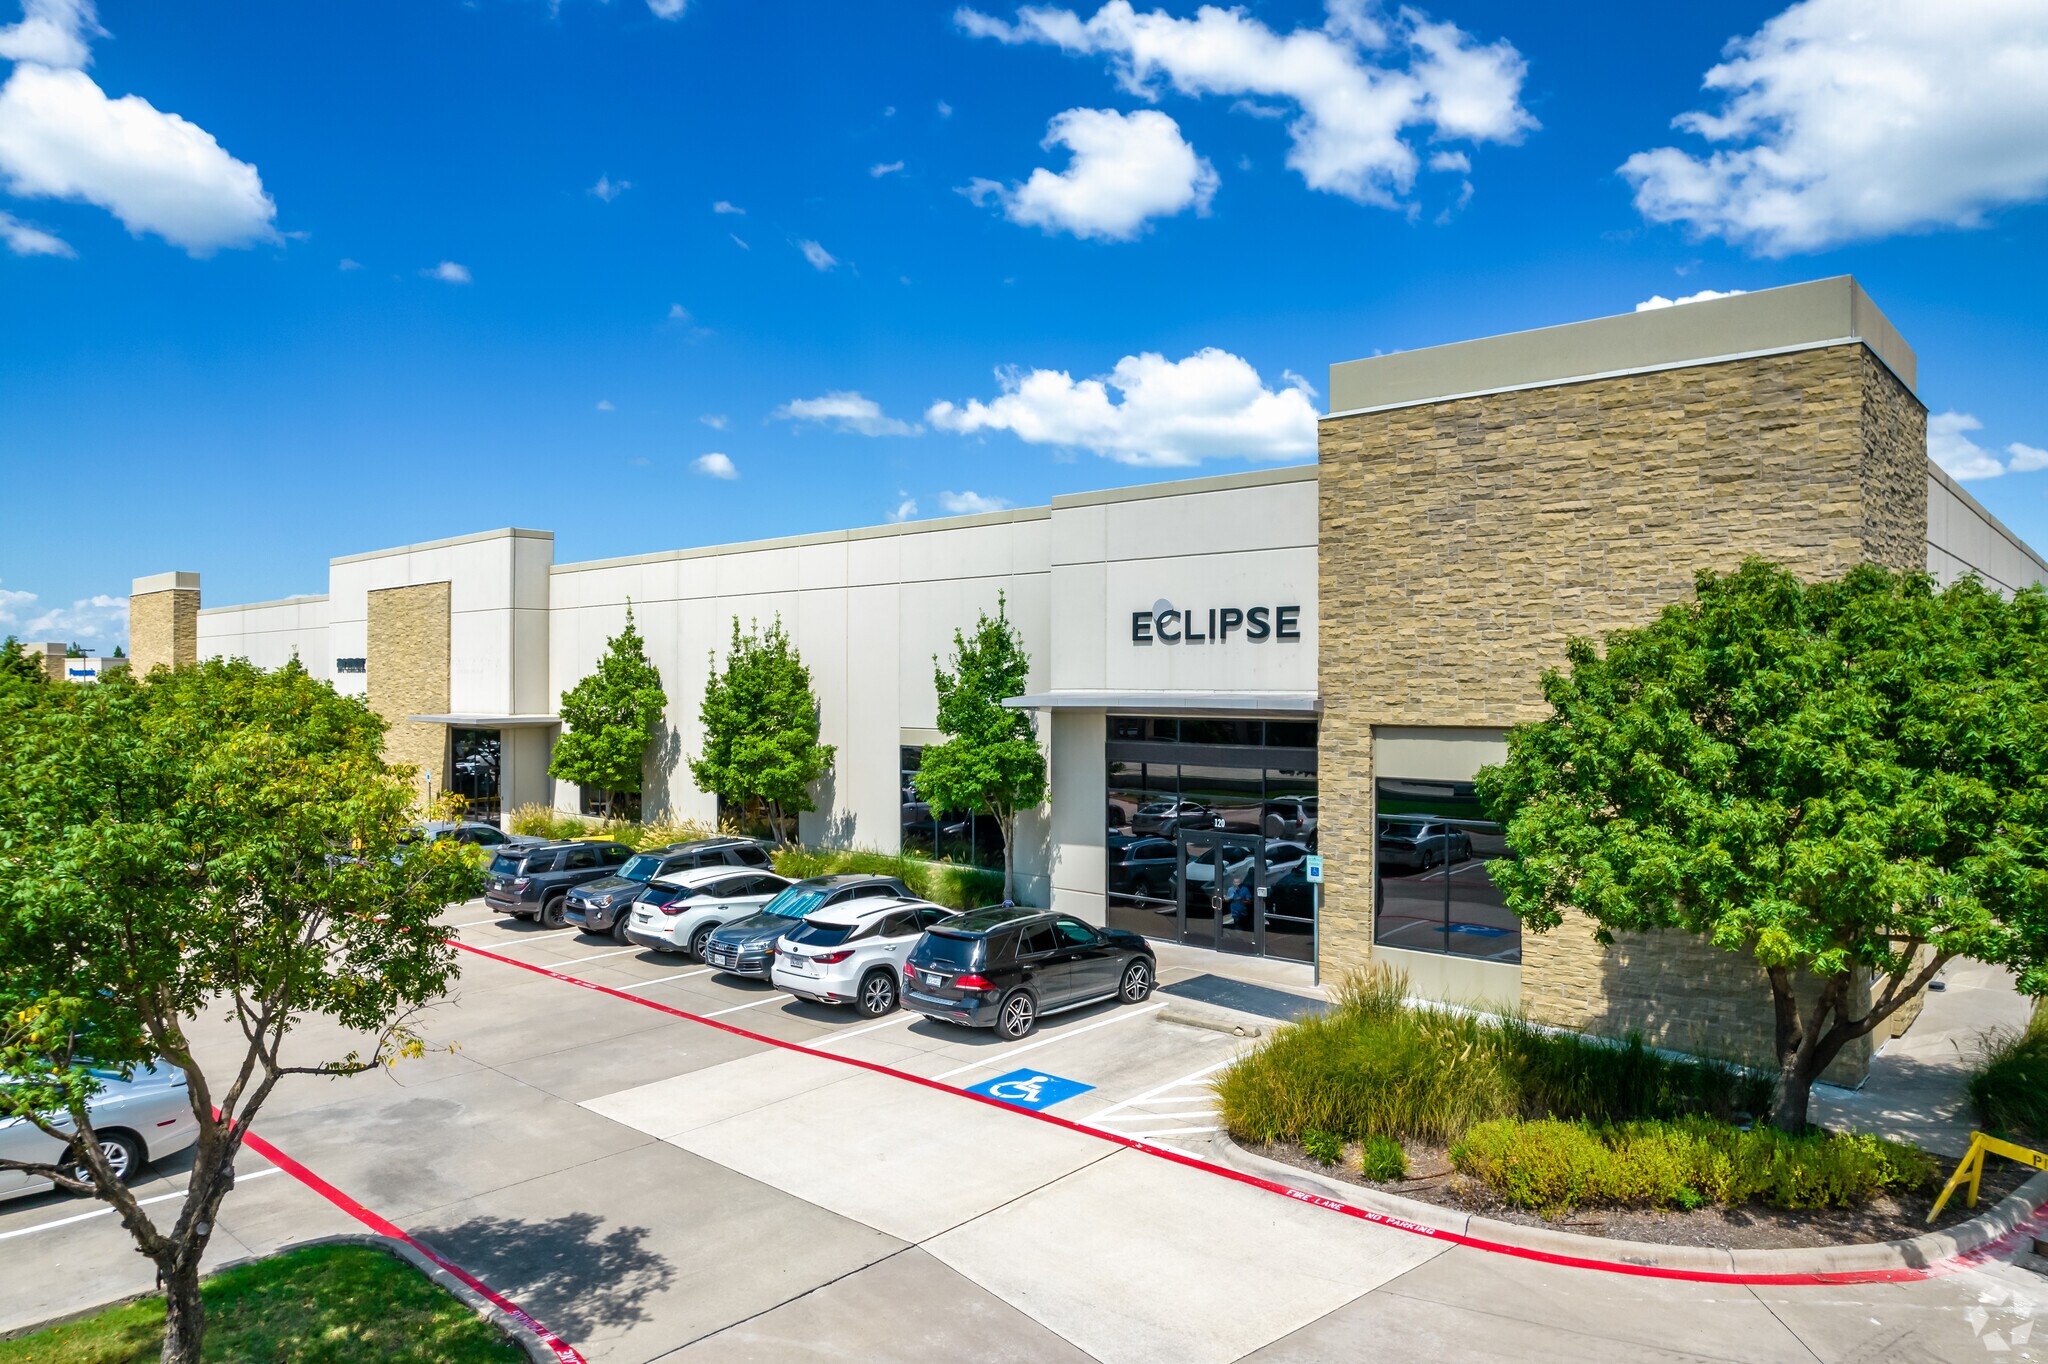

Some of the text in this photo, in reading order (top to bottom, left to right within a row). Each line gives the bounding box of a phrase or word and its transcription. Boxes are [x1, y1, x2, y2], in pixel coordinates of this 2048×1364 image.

[1132, 605, 1301, 641] ECLIPSE
[1214, 818, 1226, 828] 120
[1286, 1189, 1436, 1235] FIRE LANE NO PARKING
